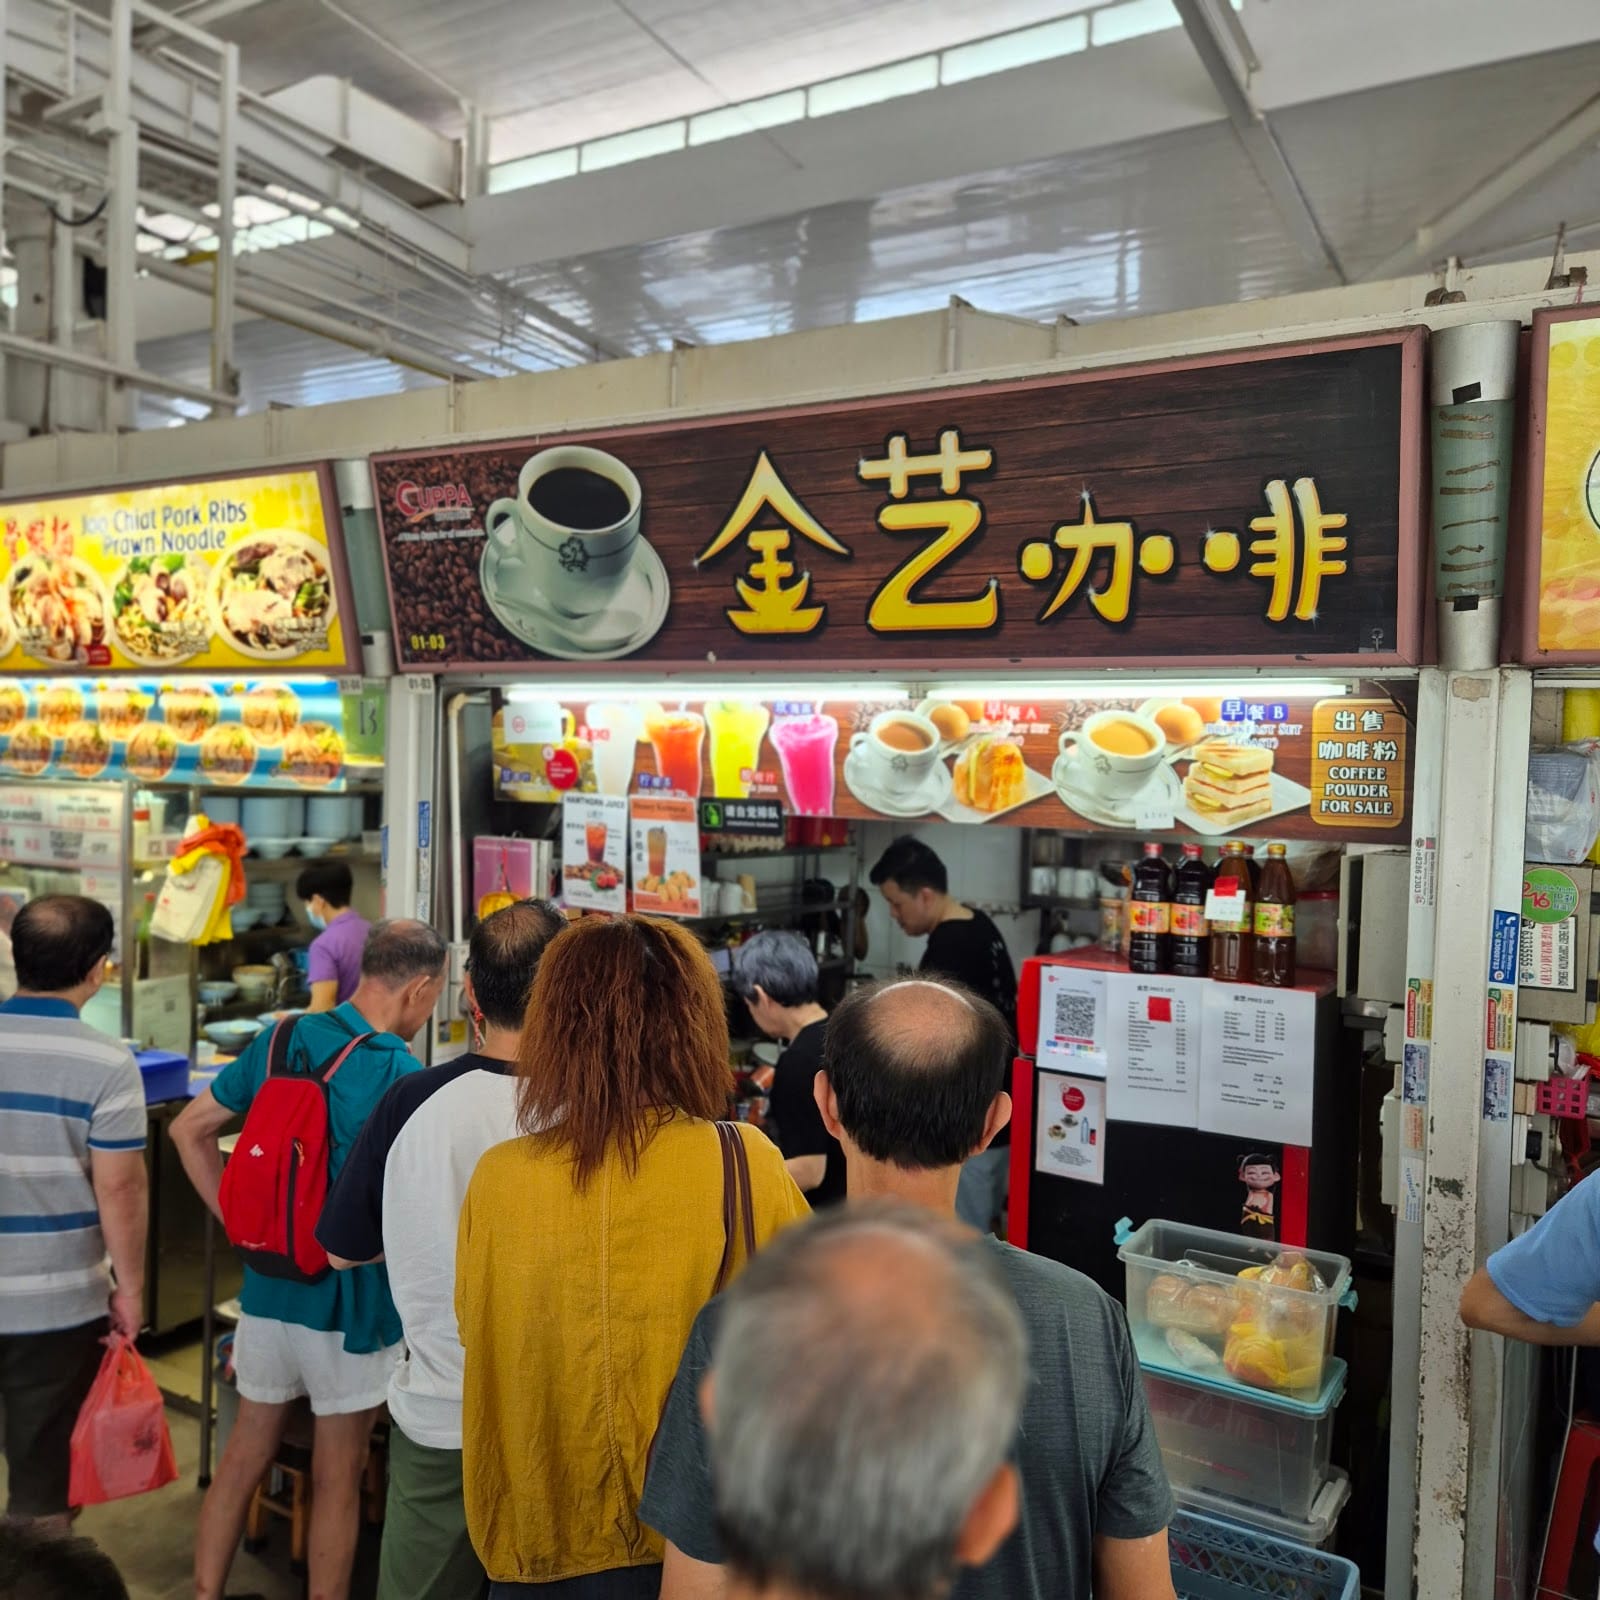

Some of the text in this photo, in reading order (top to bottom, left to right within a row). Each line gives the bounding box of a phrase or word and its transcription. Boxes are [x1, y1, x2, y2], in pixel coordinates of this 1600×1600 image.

[396, 481, 473, 516] CUPPA
[113, 507, 156, 533] Chiat
[162, 503, 201, 527] Pork
[208, 498, 247, 523] Ribs
[161, 527, 226, 553] Noodle
[692, 428, 1349, 636] 金艺咖啡
[411, 634, 446, 651] 01-03
[1025, 706, 1038, 720] A
[1223, 701, 1284, 721] 早餐 B
[1278, 724, 1302, 735] SET
[1335, 711, 1384, 731] 出售
[1319, 741, 1398, 760] 咖啡粉
[1329, 767, 1386, 780] COFFEE
[1325, 784, 1389, 798] POWDER
[1321, 800, 1393, 815] FOR SALE
